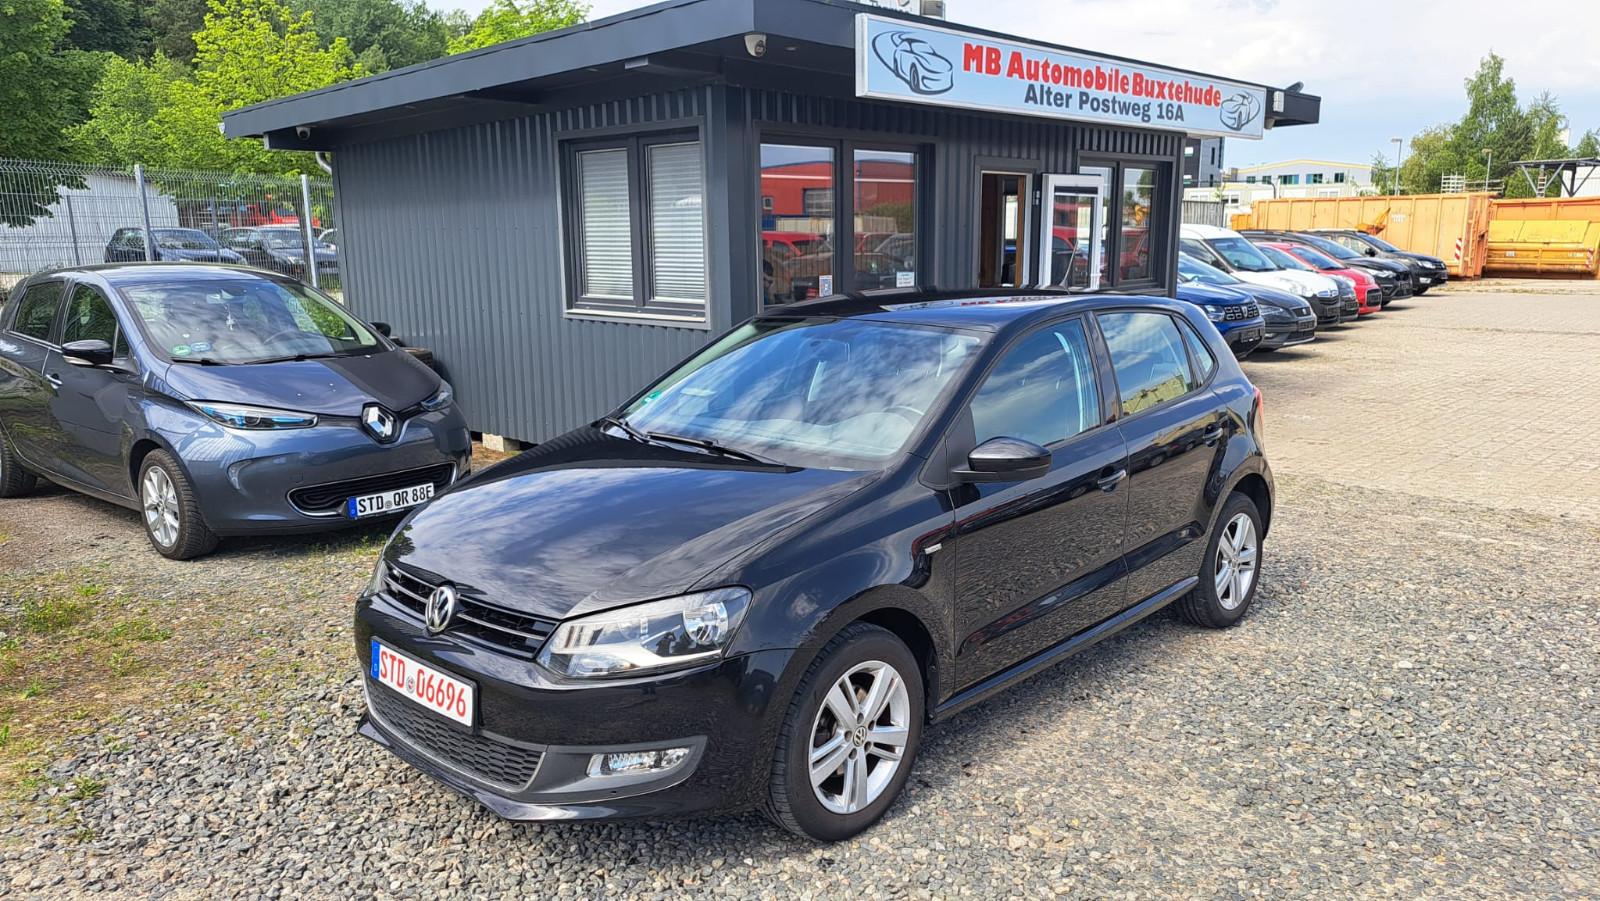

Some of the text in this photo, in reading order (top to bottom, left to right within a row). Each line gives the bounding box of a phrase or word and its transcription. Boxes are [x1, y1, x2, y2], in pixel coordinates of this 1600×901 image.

[963, 43, 1221, 107] MB Automobile Buxtehude
[1024, 84, 1185, 123] Alter Postweg 16A
[358, 495, 384, 513] STD
[393, 491, 409, 506] QR
[381, 651, 466, 716] STD 06696
